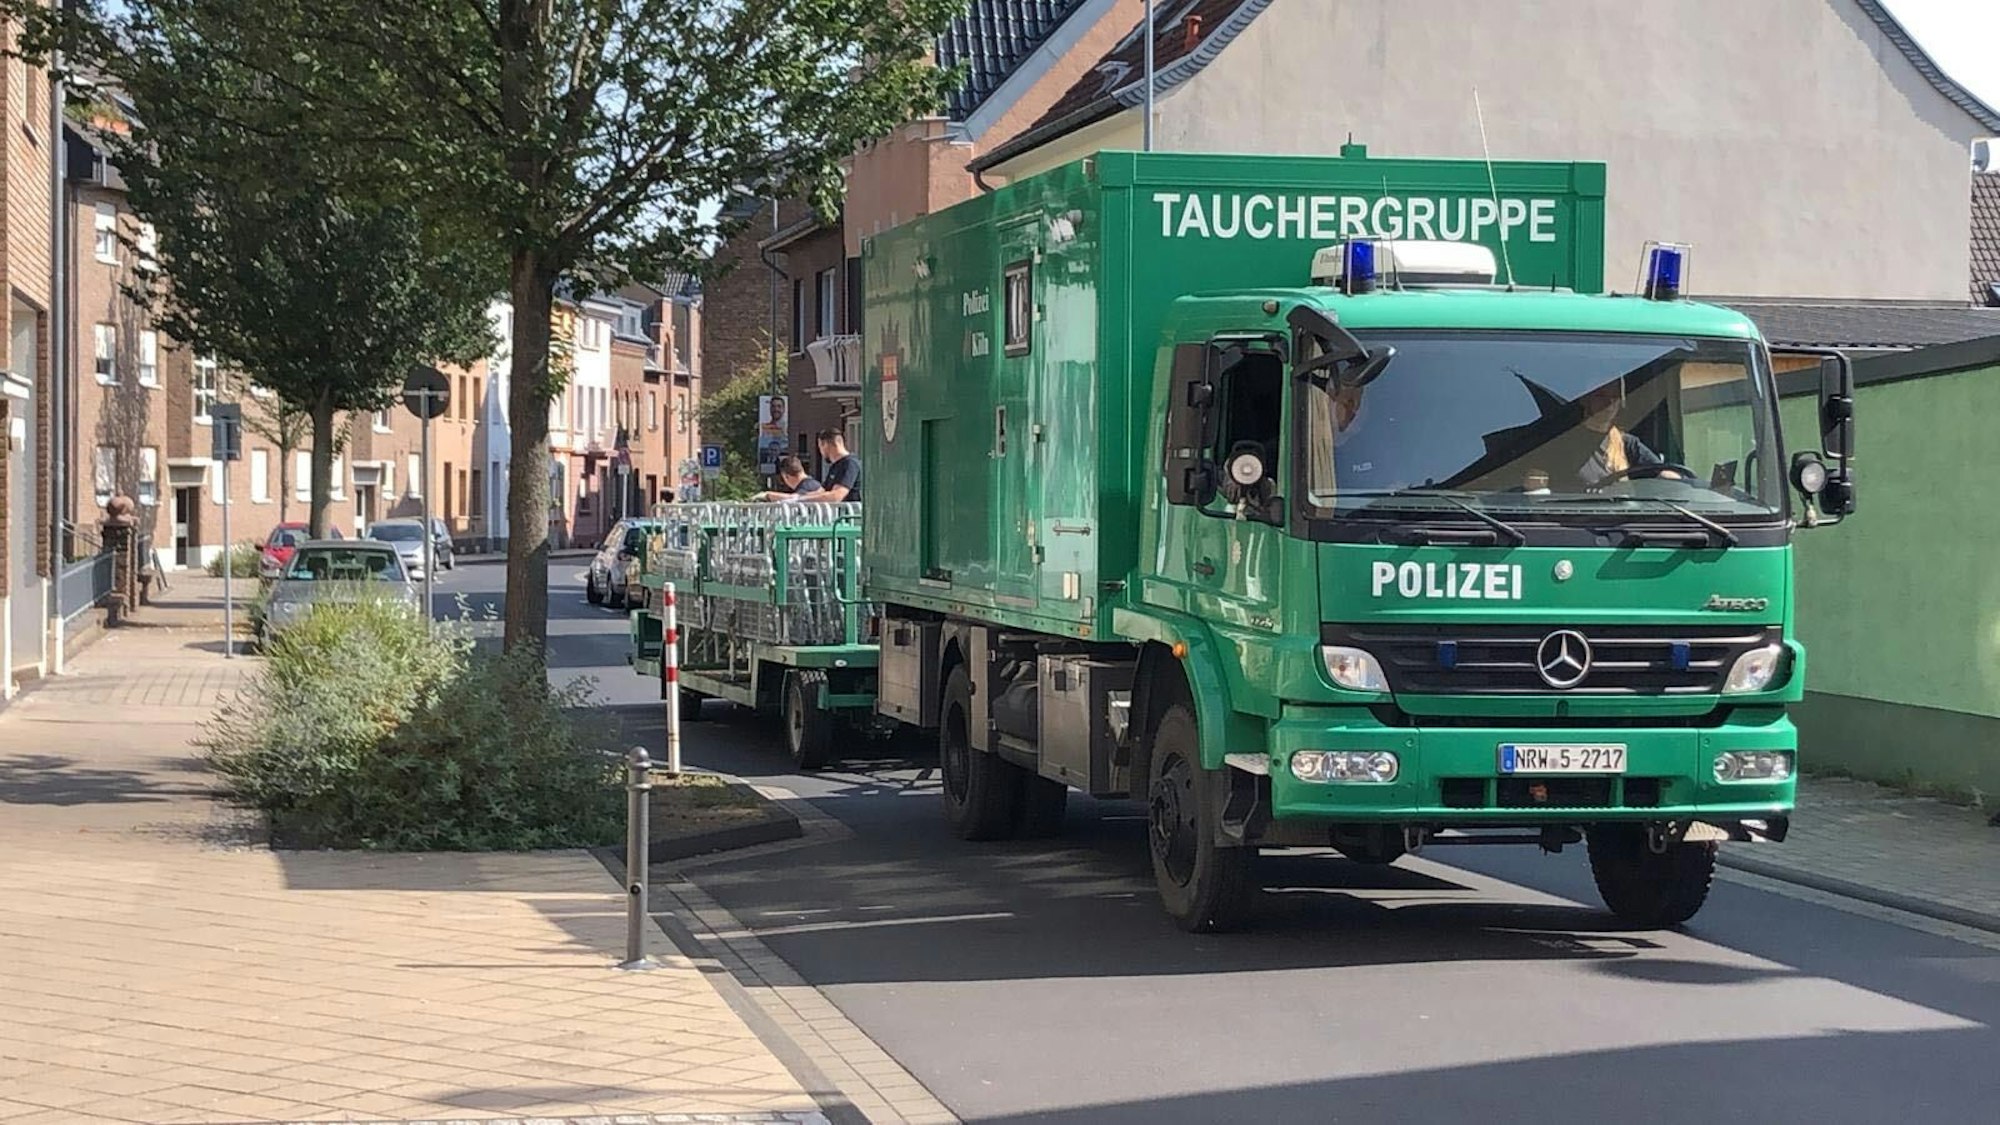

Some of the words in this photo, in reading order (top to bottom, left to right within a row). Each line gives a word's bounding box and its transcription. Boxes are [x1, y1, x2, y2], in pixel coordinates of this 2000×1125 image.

[1153, 193, 1556, 242] TAUCHERGRUPPE
[963, 286, 990, 316] Polizei
[706, 448, 717, 464] P
[1372, 561, 1522, 599] POLIZEI
[1516, 749, 1548, 768] NRW
[1560, 749, 1623, 768] 5-2717
